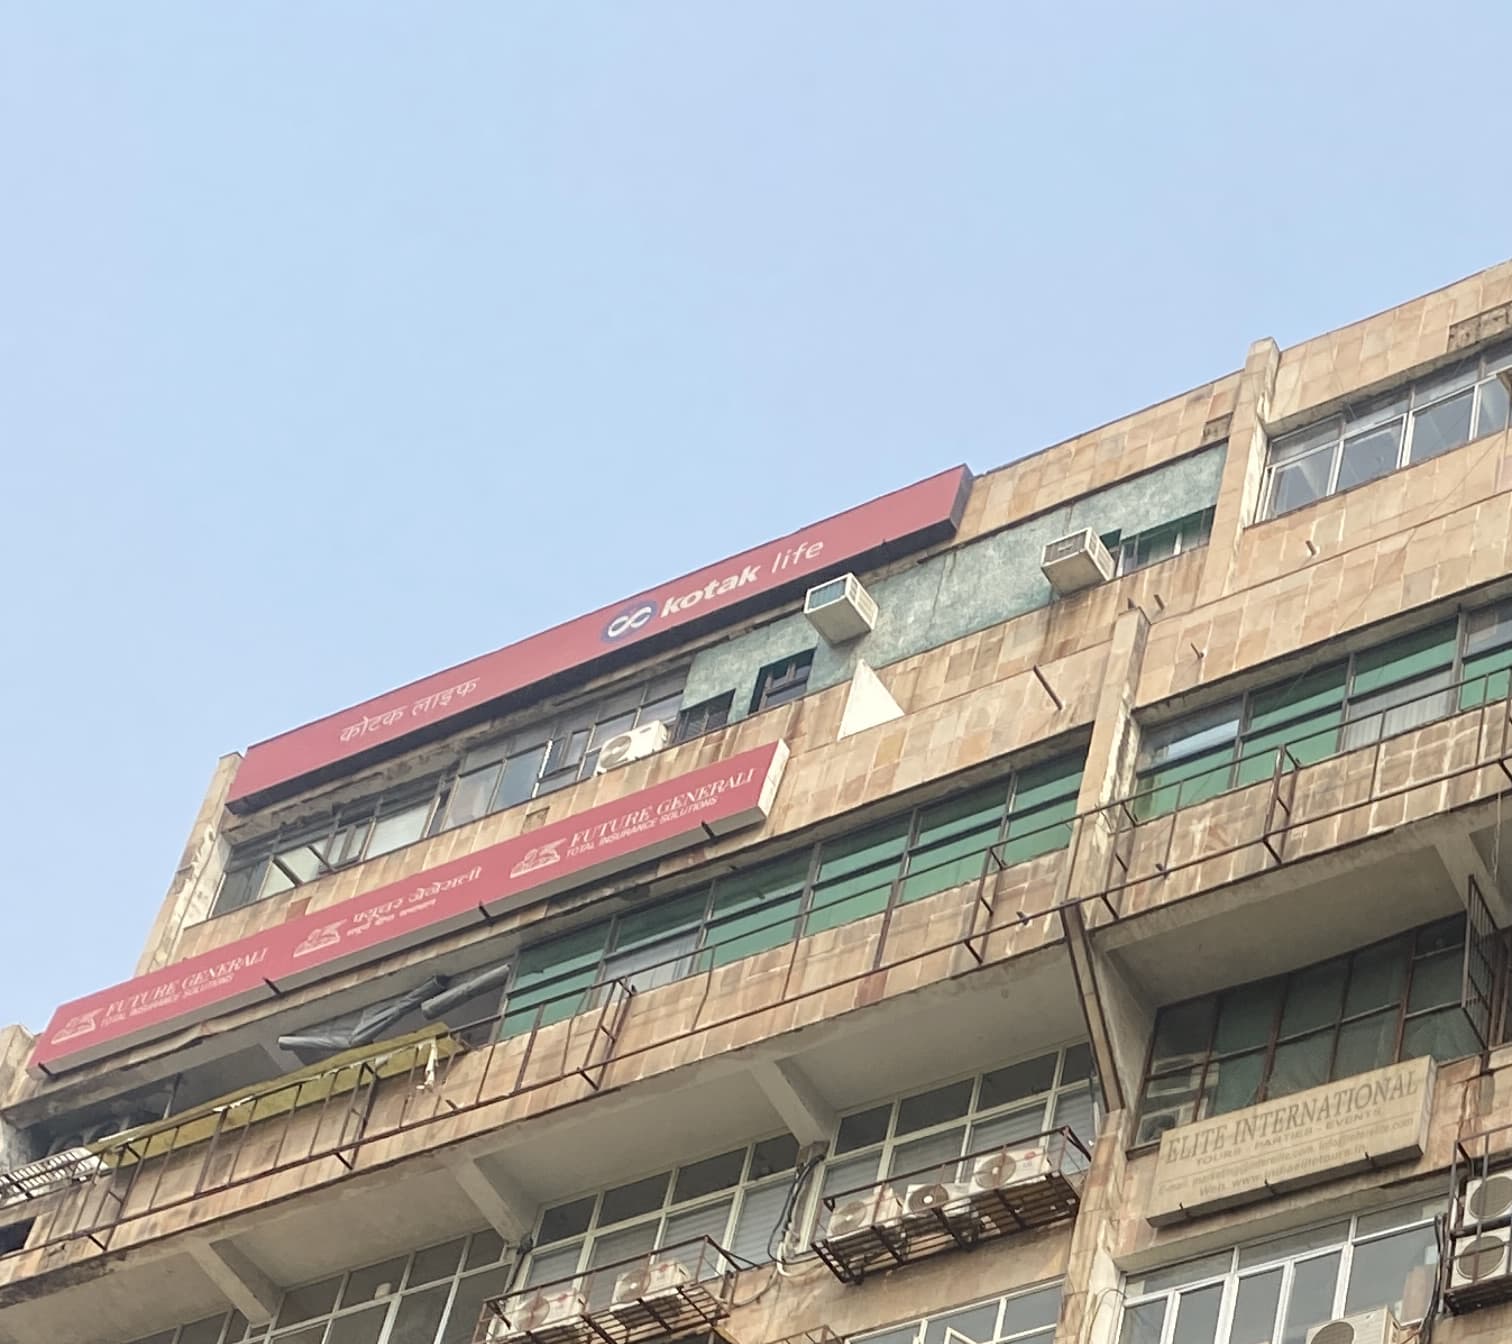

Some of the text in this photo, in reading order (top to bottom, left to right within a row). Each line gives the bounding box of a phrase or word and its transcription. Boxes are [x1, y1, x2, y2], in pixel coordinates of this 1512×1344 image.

[660, 541, 823, 618] kotak life
[340, 677, 480, 742] कोटक लाइफ
[568, 767, 756, 847] FUTURE GENERALI
[105, 948, 268, 1017] FUTURE GENERALI
[1165, 1124, 1228, 1165] ELITE
[1232, 1070, 1419, 1147] INTERNATIONAL
